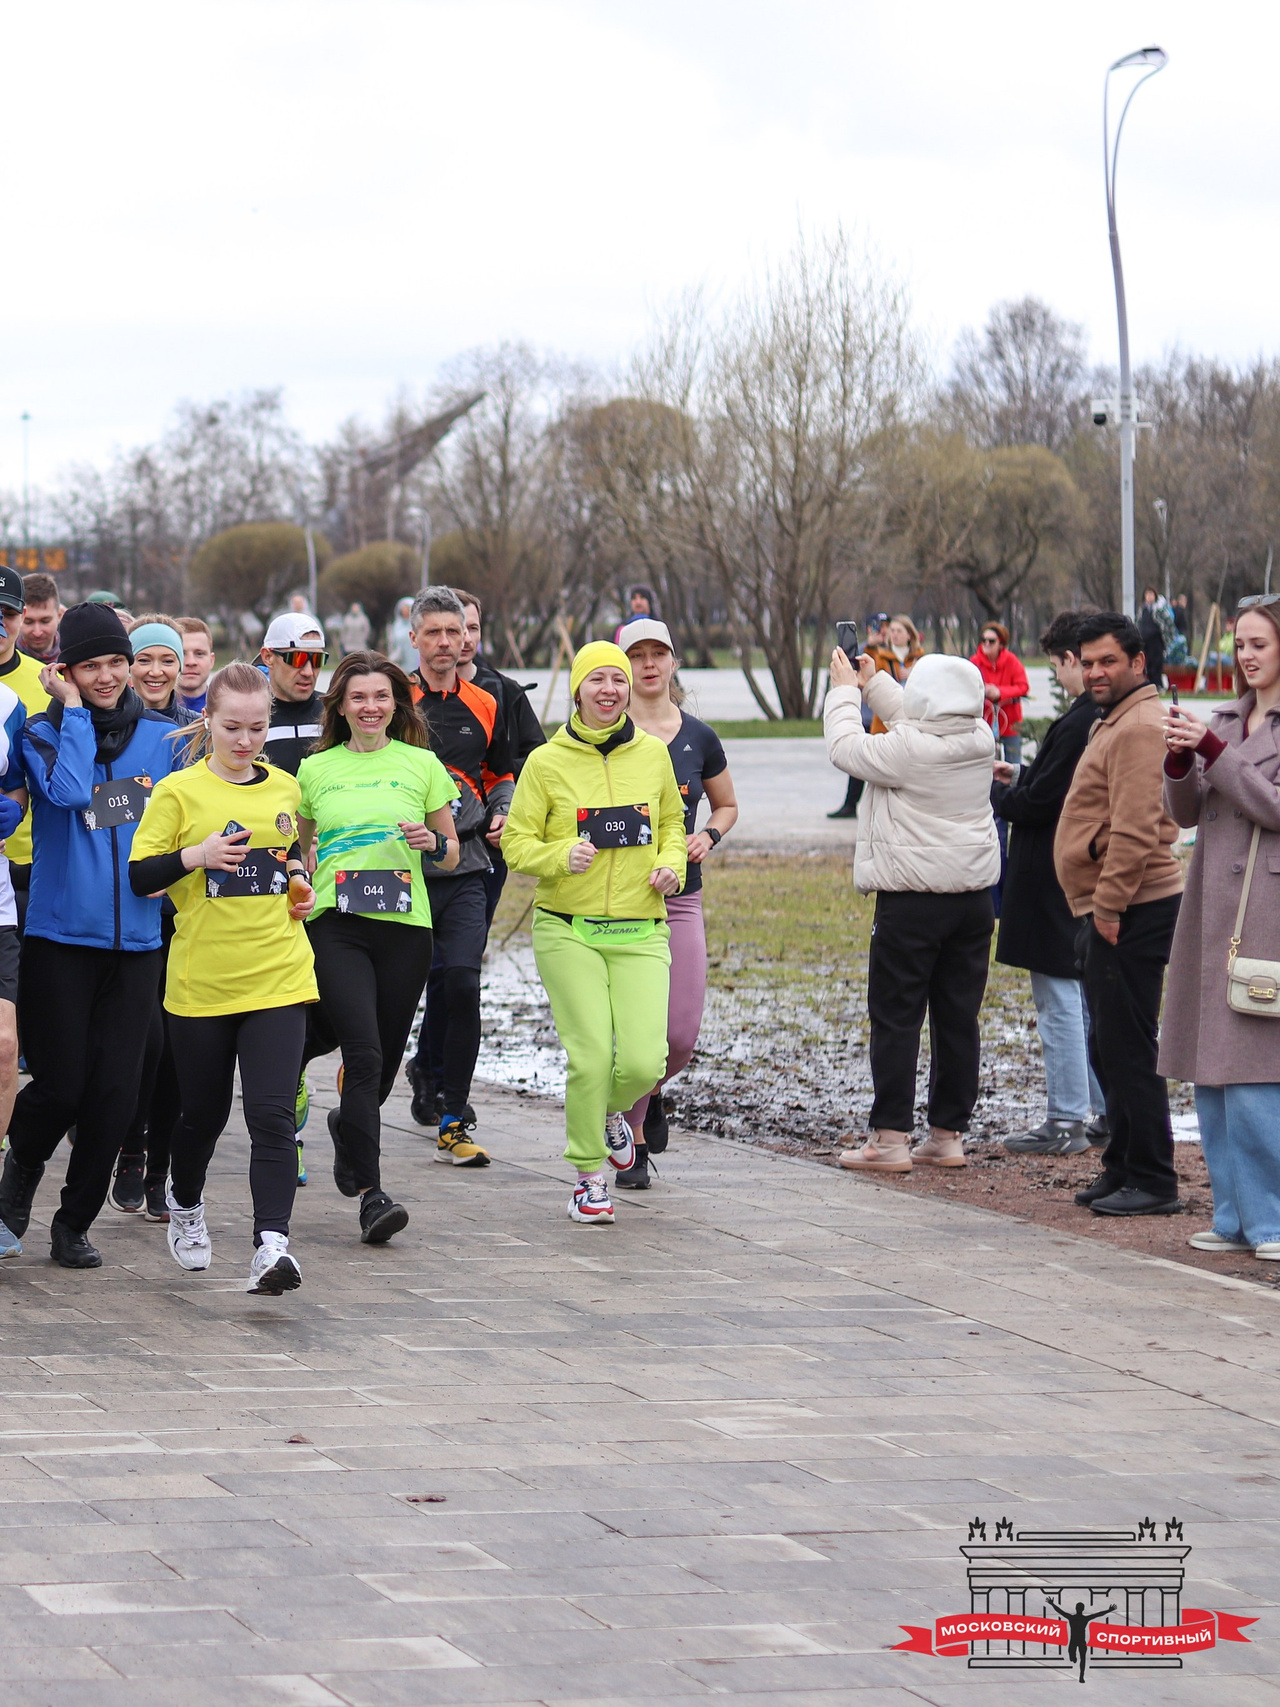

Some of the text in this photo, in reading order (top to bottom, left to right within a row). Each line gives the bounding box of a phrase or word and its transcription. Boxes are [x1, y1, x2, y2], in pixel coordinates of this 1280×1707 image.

[108, 795, 129, 808] 018
[605, 821, 626, 832] 030
[237, 866, 258, 877] 012
[363, 885, 384, 896] 044
